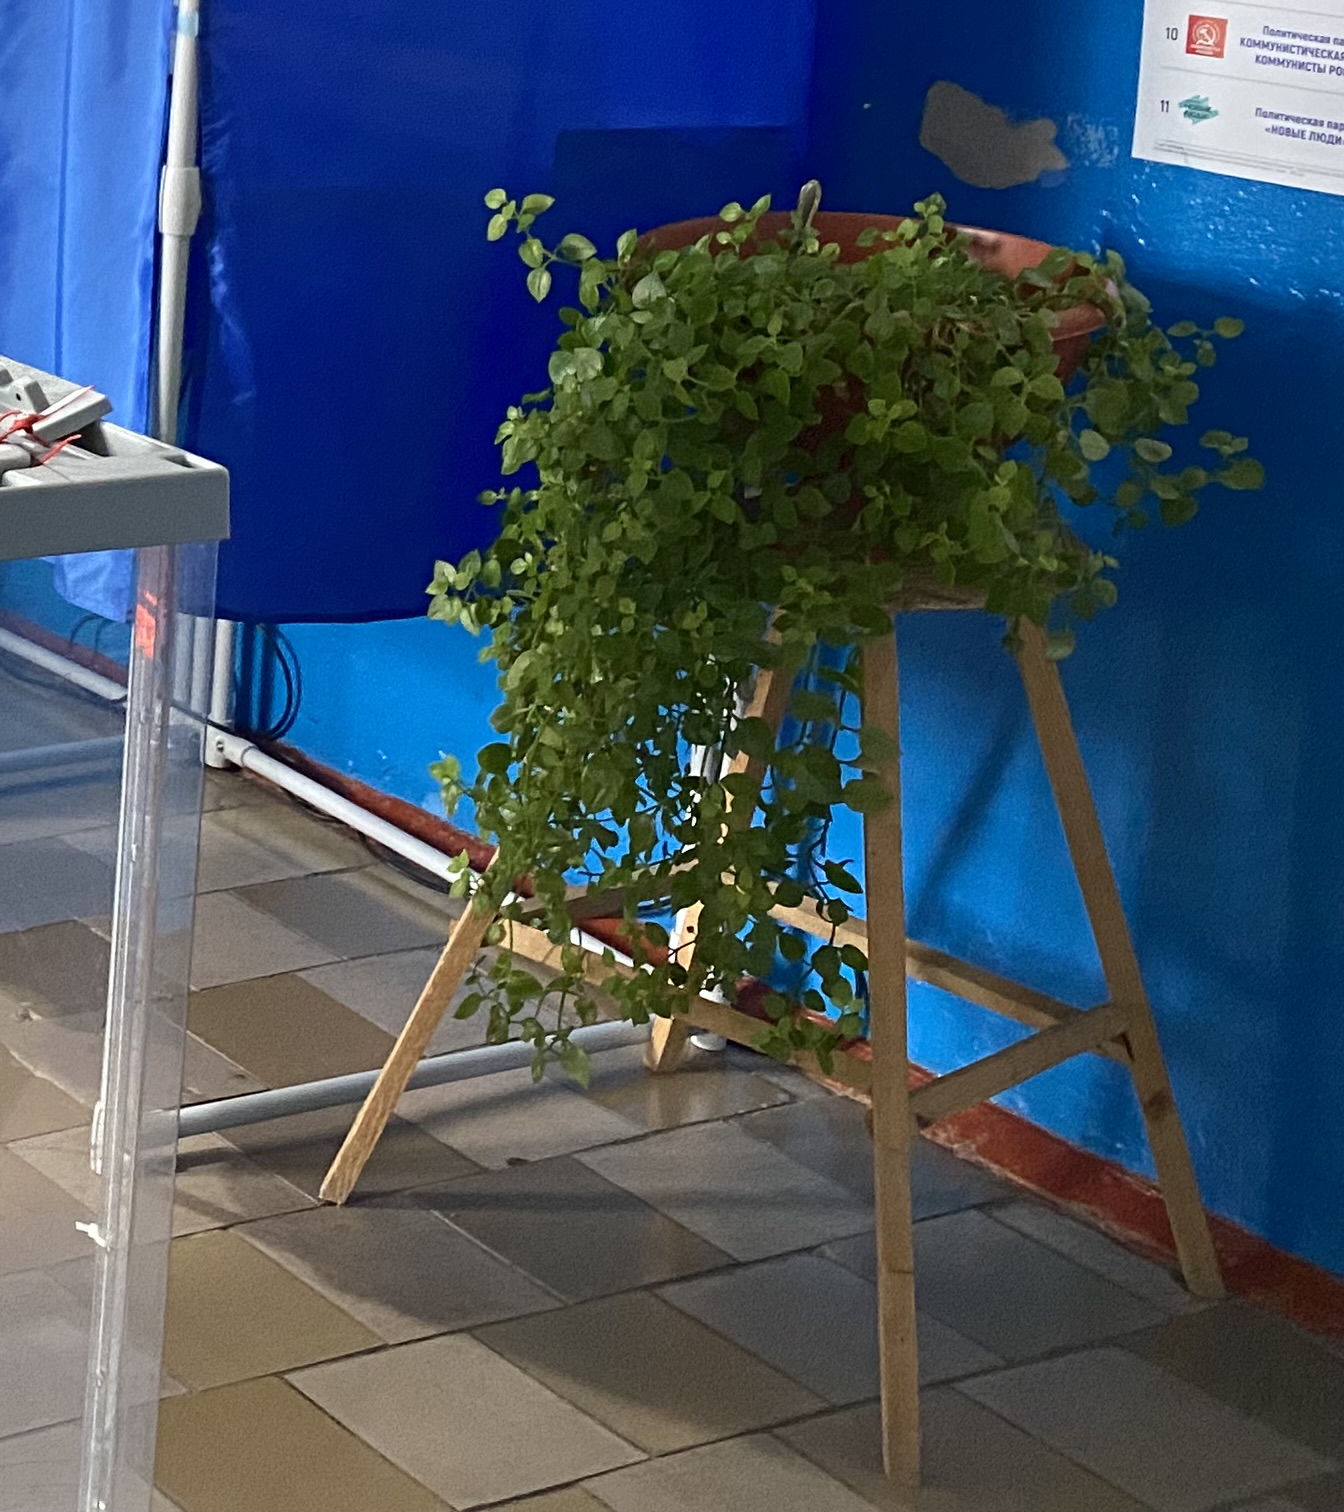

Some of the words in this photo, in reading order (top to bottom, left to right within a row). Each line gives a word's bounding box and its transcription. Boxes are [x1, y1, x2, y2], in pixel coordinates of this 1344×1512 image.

[1165, 26, 1179, 41] 10
[1262, 25, 1331, 44] Политическая
[1255, 54, 1326, 74] КОММУНИСТЫ
[1160, 99, 1170, 113] 11
[1255, 107, 1325, 127] Политическая
